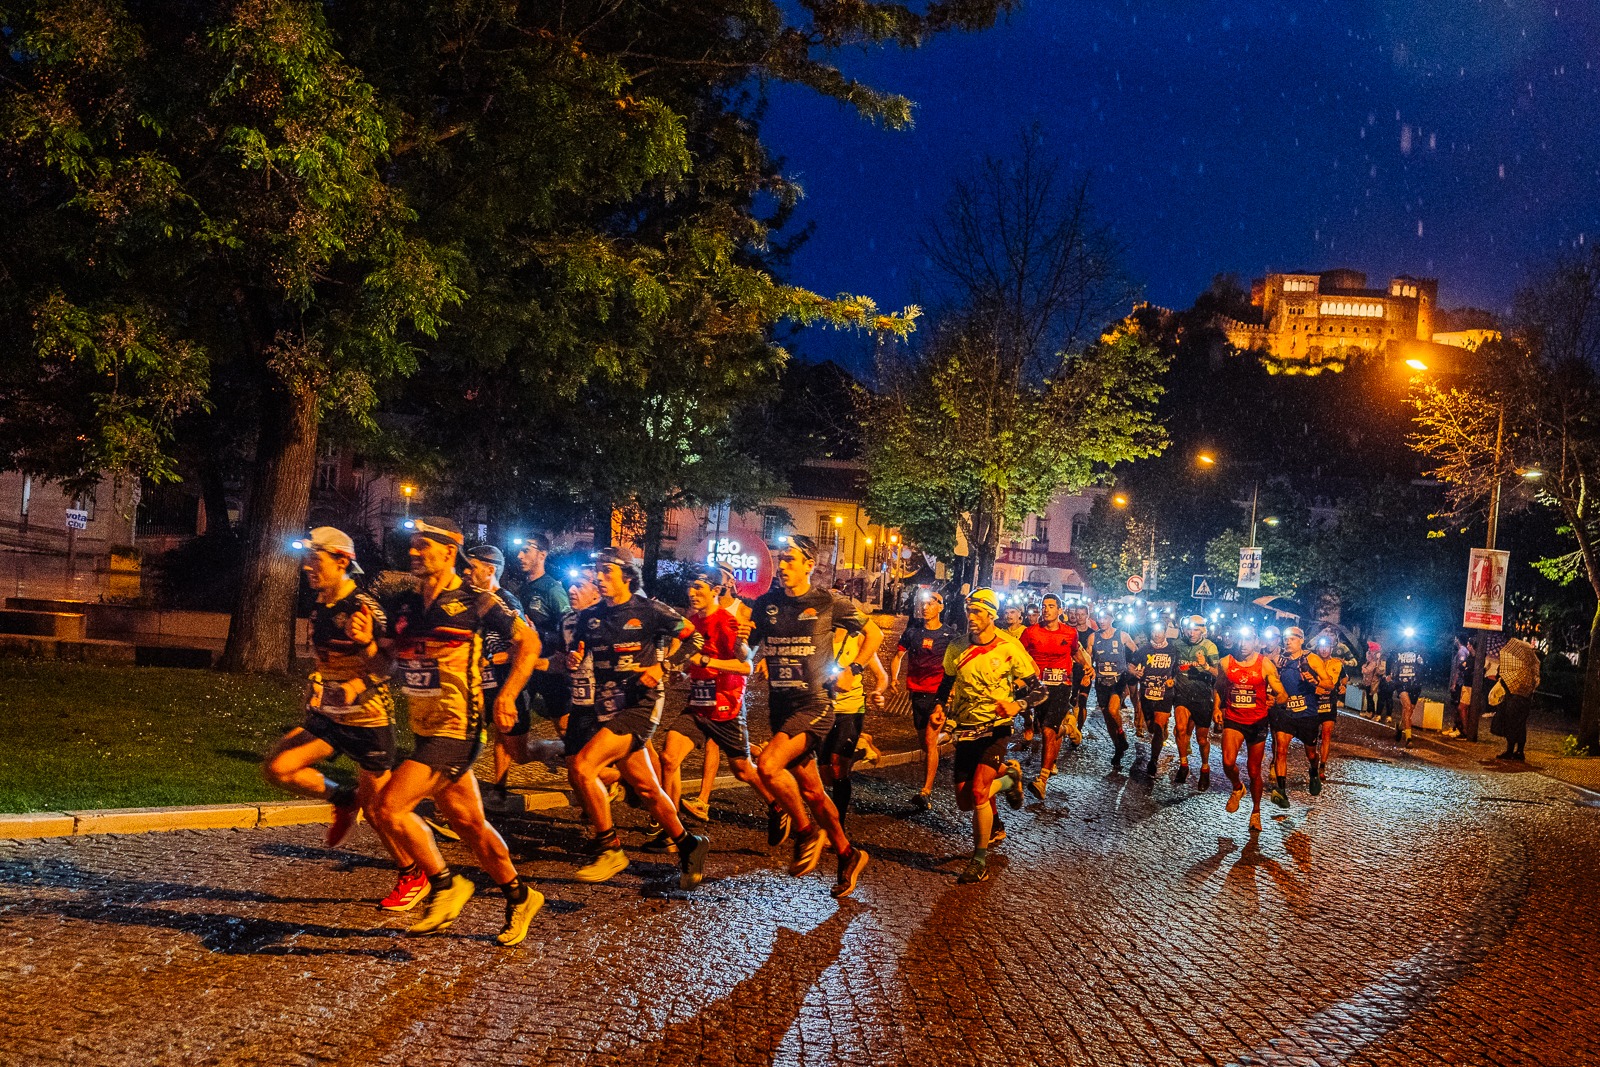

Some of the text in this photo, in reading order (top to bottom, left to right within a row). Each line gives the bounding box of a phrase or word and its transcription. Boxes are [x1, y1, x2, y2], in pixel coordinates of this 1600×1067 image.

[66, 513, 87, 521] vota
[708, 537, 741, 554] não
[707, 553, 758, 569] existe
[1008, 550, 1048, 565] LEIRIA
